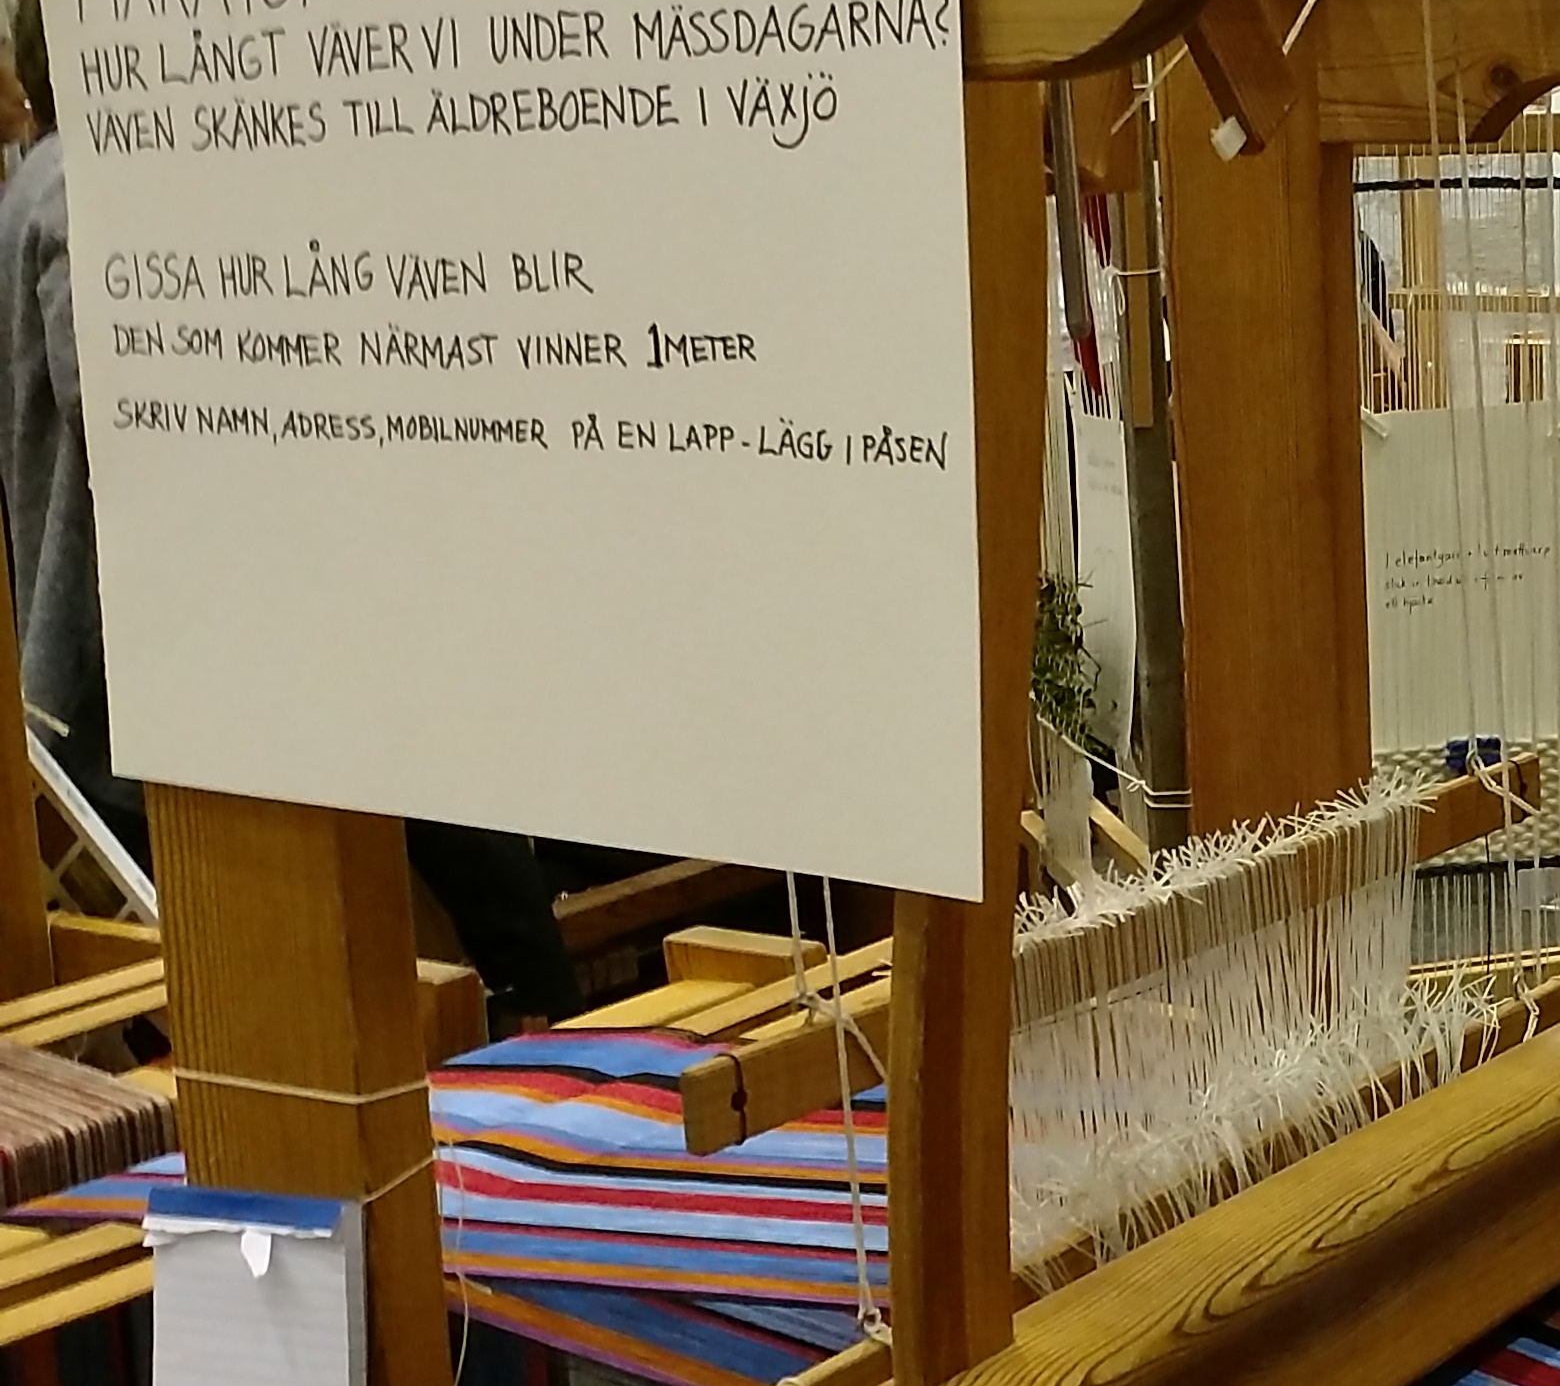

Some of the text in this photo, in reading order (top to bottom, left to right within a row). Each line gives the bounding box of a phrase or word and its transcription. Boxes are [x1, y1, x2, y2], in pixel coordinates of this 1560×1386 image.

[79, 43, 148, 97] HUR
[159, 26, 287, 86] LÅNGT
[307, 21, 415, 79] VÄVER
[420, 16, 460, 71] VI
[488, 8, 610, 65] UNDER
[190, 97, 328, 153] SKÄNKES
[342, 96, 415, 138] TILL
[426, 83, 680, 137] ÄLDREBOENDE
[698, 84, 708, 127] I
[104, 238, 594, 302] GISSA HUR LÅNG VÄVEN BLIR
[112, 320, 166, 358] DEN
[171, 324, 223, 361] SOM
[236, 326, 342, 368] KOMMER
[359, 322, 499, 371] NÄRMAST
[516, 330, 627, 370] VINNER
[112, 397, 188, 433] SKRIV
[386, 413, 549, 450] MOBILNUMMER
[570, 413, 604, 451] PÅ
[616, 419, 656, 451] EN
[757, 416, 834, 461] LÄGG
[844, 434, 852, 466] I
[861, 424, 949, 472] PÅSEN
